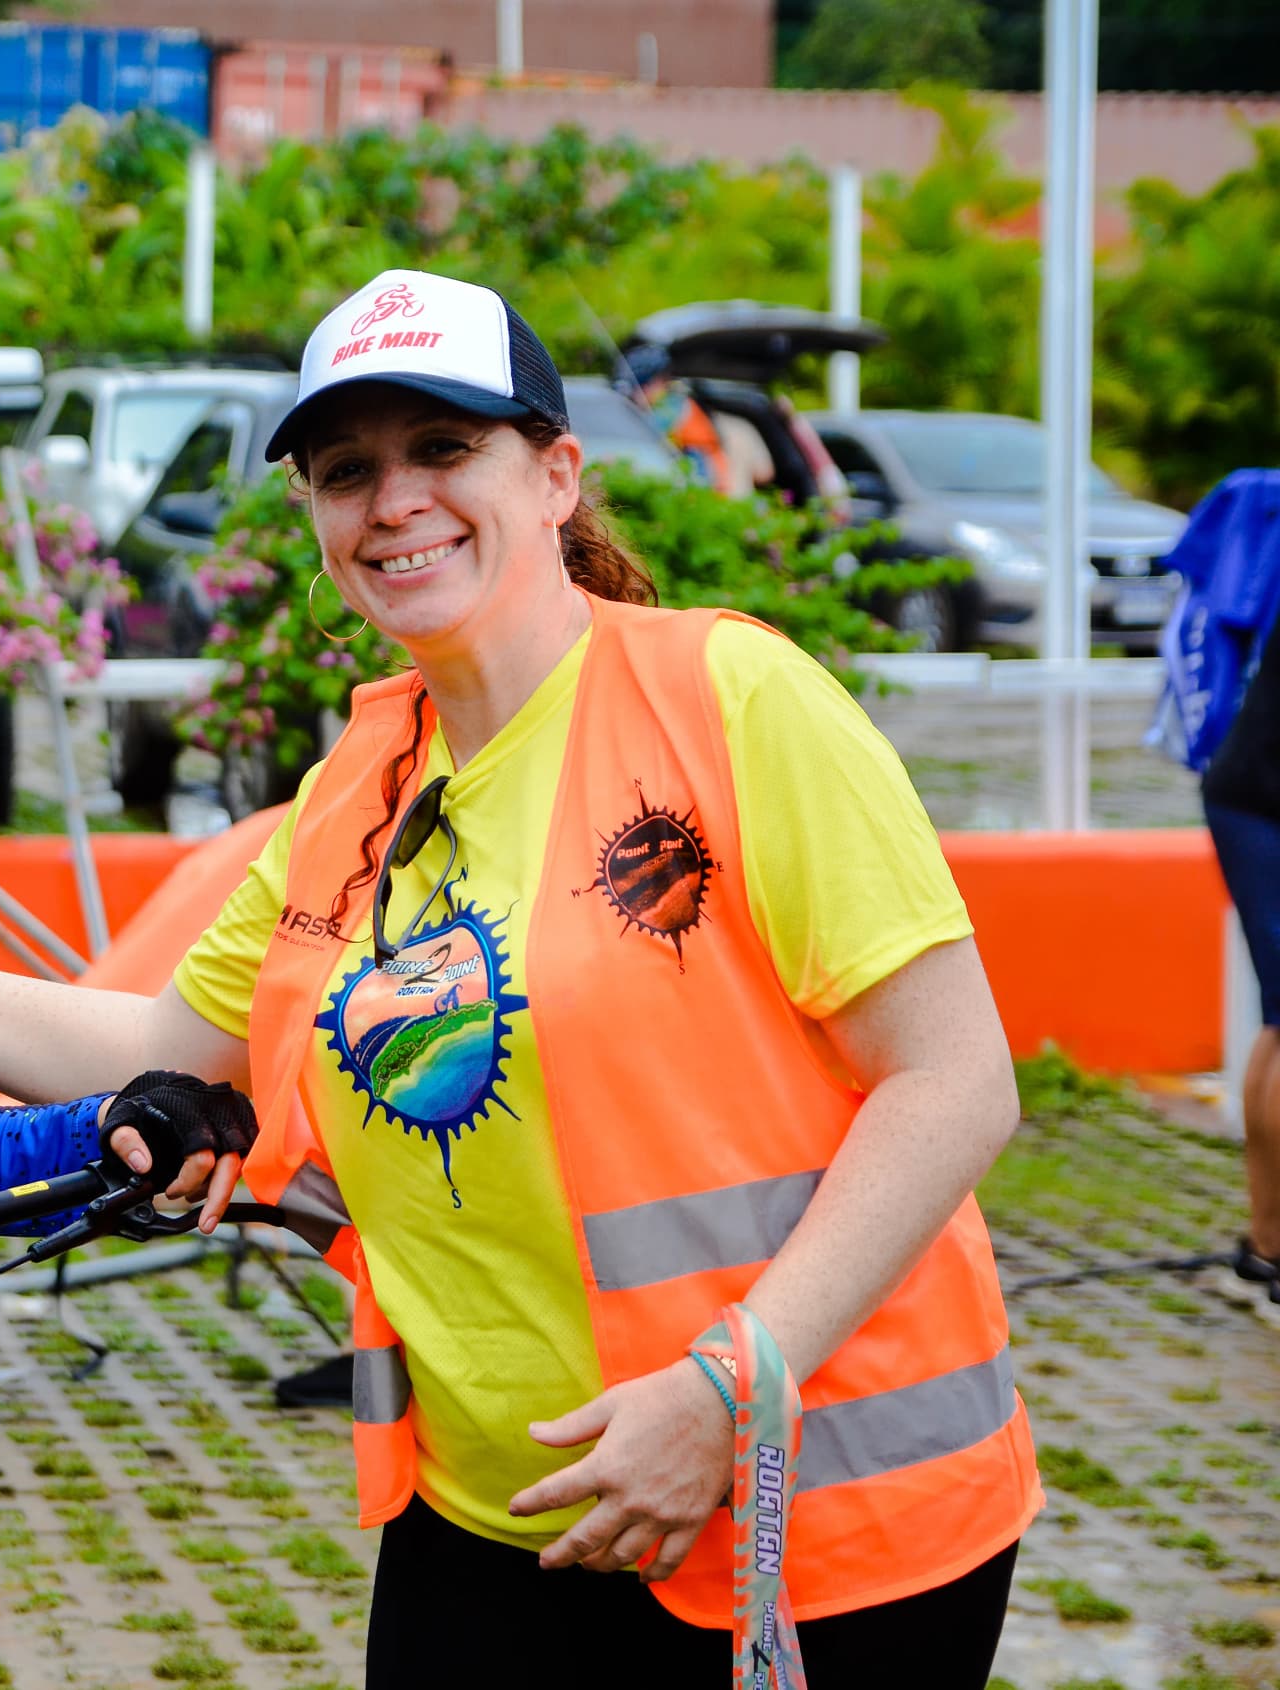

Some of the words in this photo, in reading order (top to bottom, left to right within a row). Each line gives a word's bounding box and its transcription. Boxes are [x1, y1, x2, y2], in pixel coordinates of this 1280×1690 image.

[331, 335, 376, 367] BIKE
[378, 331, 443, 350] MART
[378, 959, 433, 976] POINT
[438, 953, 481, 983] POINT
[450, 1188, 462, 1209] S
[755, 1443, 785, 1576] ROATAN
[762, 1600, 776, 1652] POINT
